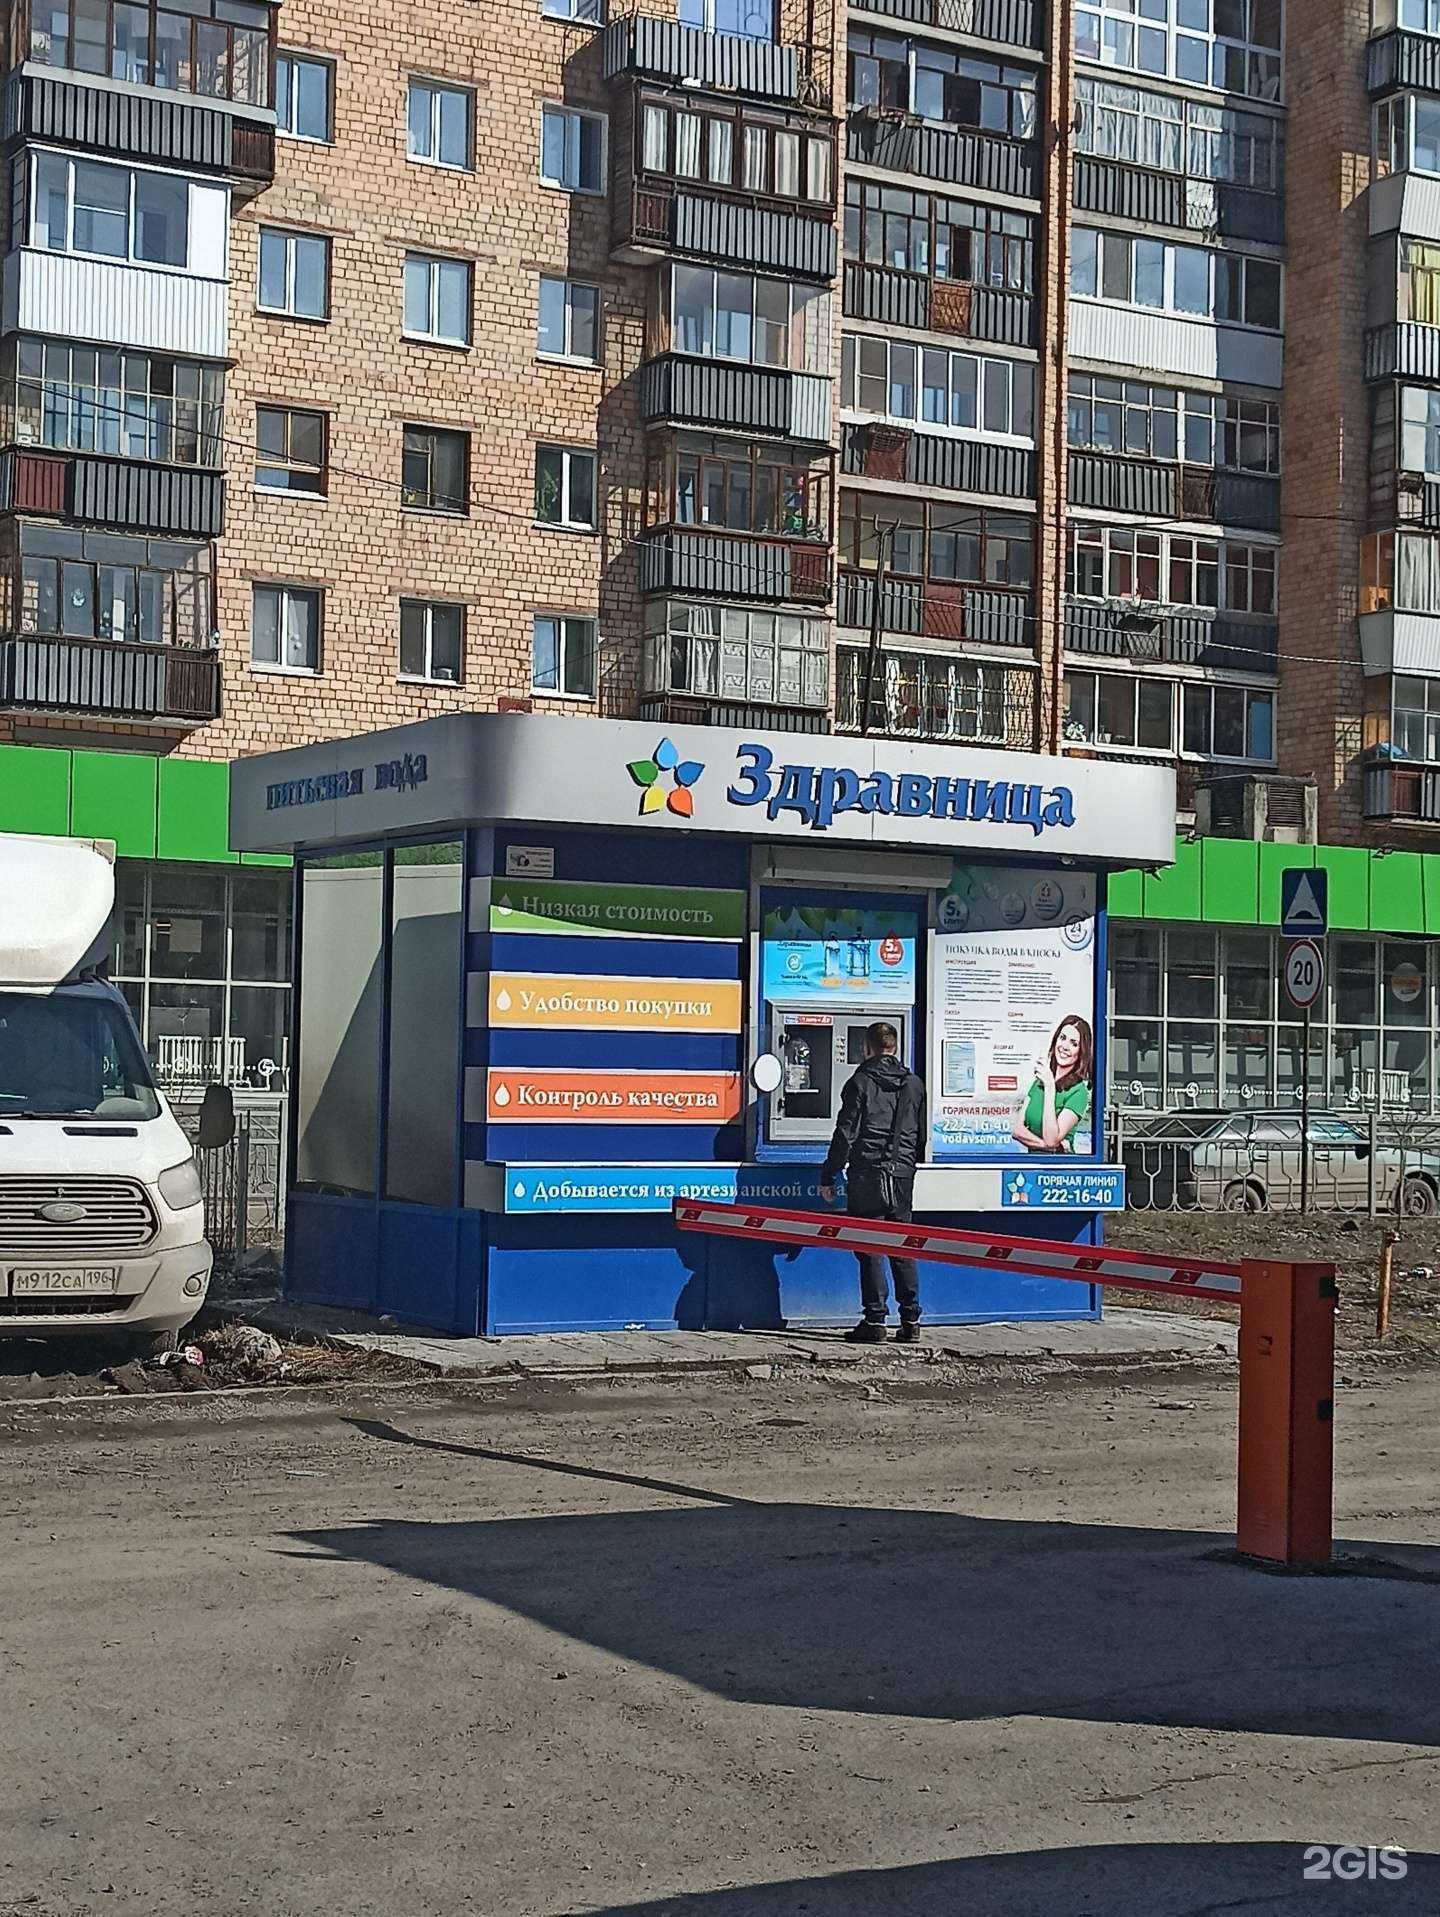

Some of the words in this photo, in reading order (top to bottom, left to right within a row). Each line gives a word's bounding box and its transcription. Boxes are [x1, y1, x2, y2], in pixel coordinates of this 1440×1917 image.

[727, 743, 1076, 836] Здравница
[522, 896, 600, 918] Низкая
[606, 903, 714, 924] стоимость
[1293, 961, 1314, 986] 20
[519, 991, 619, 1014] Удобство
[624, 998, 712, 1020] покупки
[518, 1085, 622, 1110] Контроль
[627, 1091, 718, 1109] качества
[943, 1106, 980, 1115] ГОРЯЧАЯ
[943, 1133, 1011, 1144] vodavsem.ru
[533, 1181, 649, 1203] Добывается
[655, 1185, 674, 1198] из
[680, 1180, 802, 1200] артезианской
[1037, 1175, 1082, 1187] ГОРЯЧАЯ
[1083, 1177, 1117, 1188] ЛИНИЯ
[1042, 1189, 1112, 1204] 222-16-40
